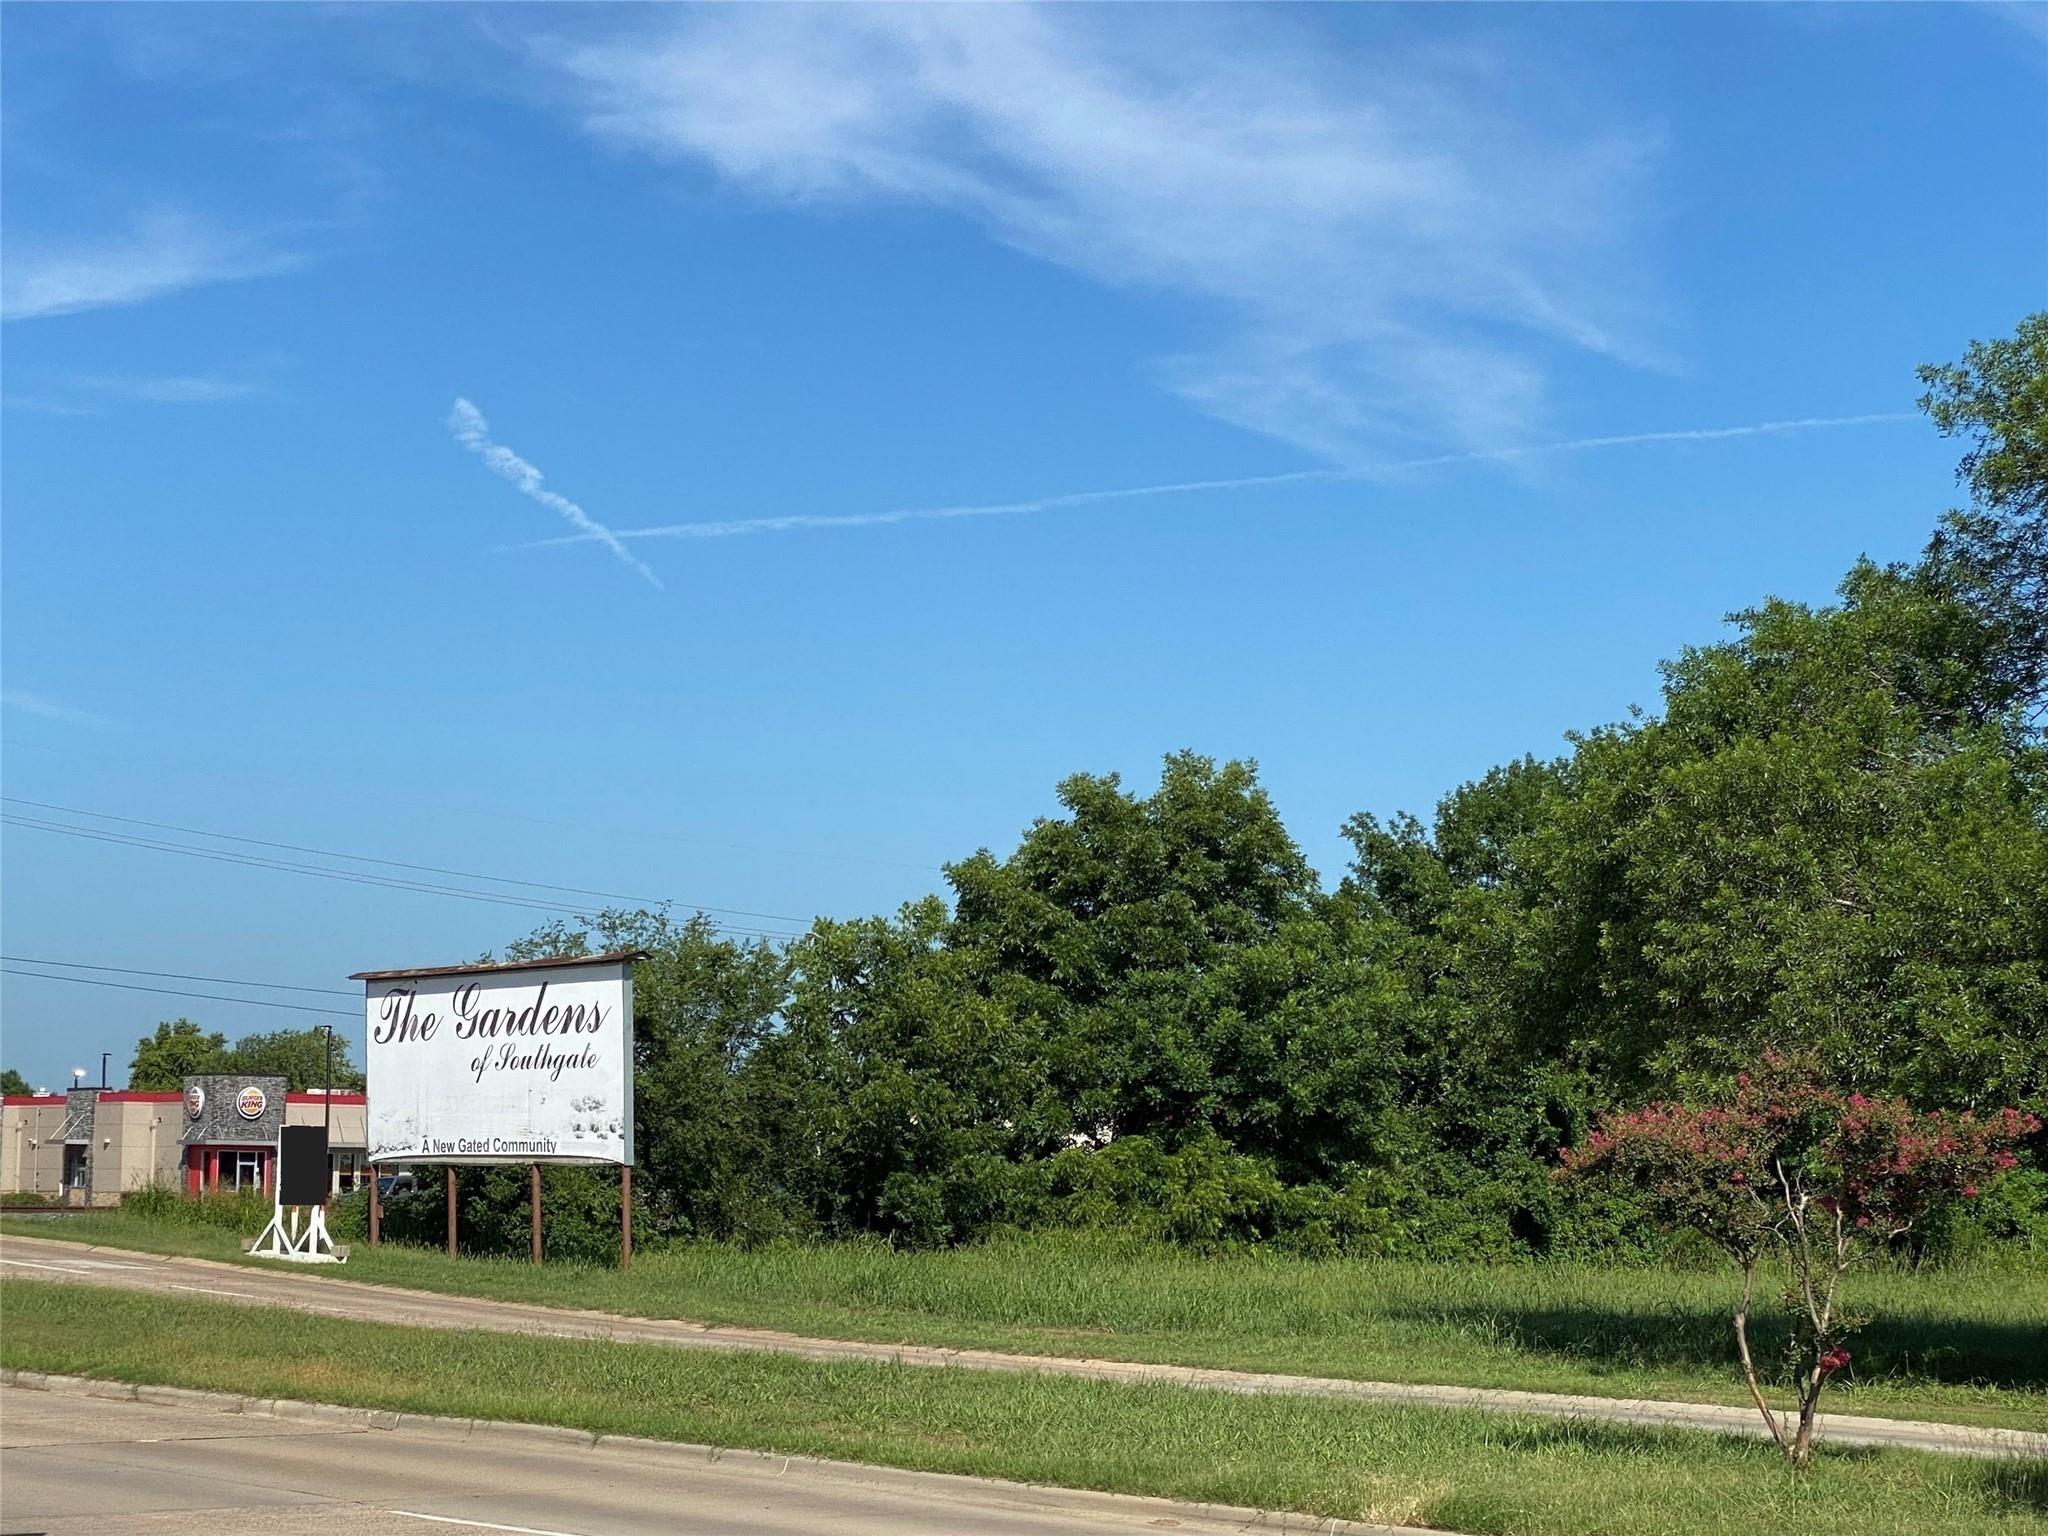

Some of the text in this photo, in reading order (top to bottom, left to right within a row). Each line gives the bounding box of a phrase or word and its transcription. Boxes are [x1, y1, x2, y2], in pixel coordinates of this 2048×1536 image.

[374, 981, 612, 1044] The Gardens
[471, 1042, 600, 1083] of Southgate
[241, 1101, 263, 1109] KING
[422, 1138, 557, 1154] A New Gated Community
